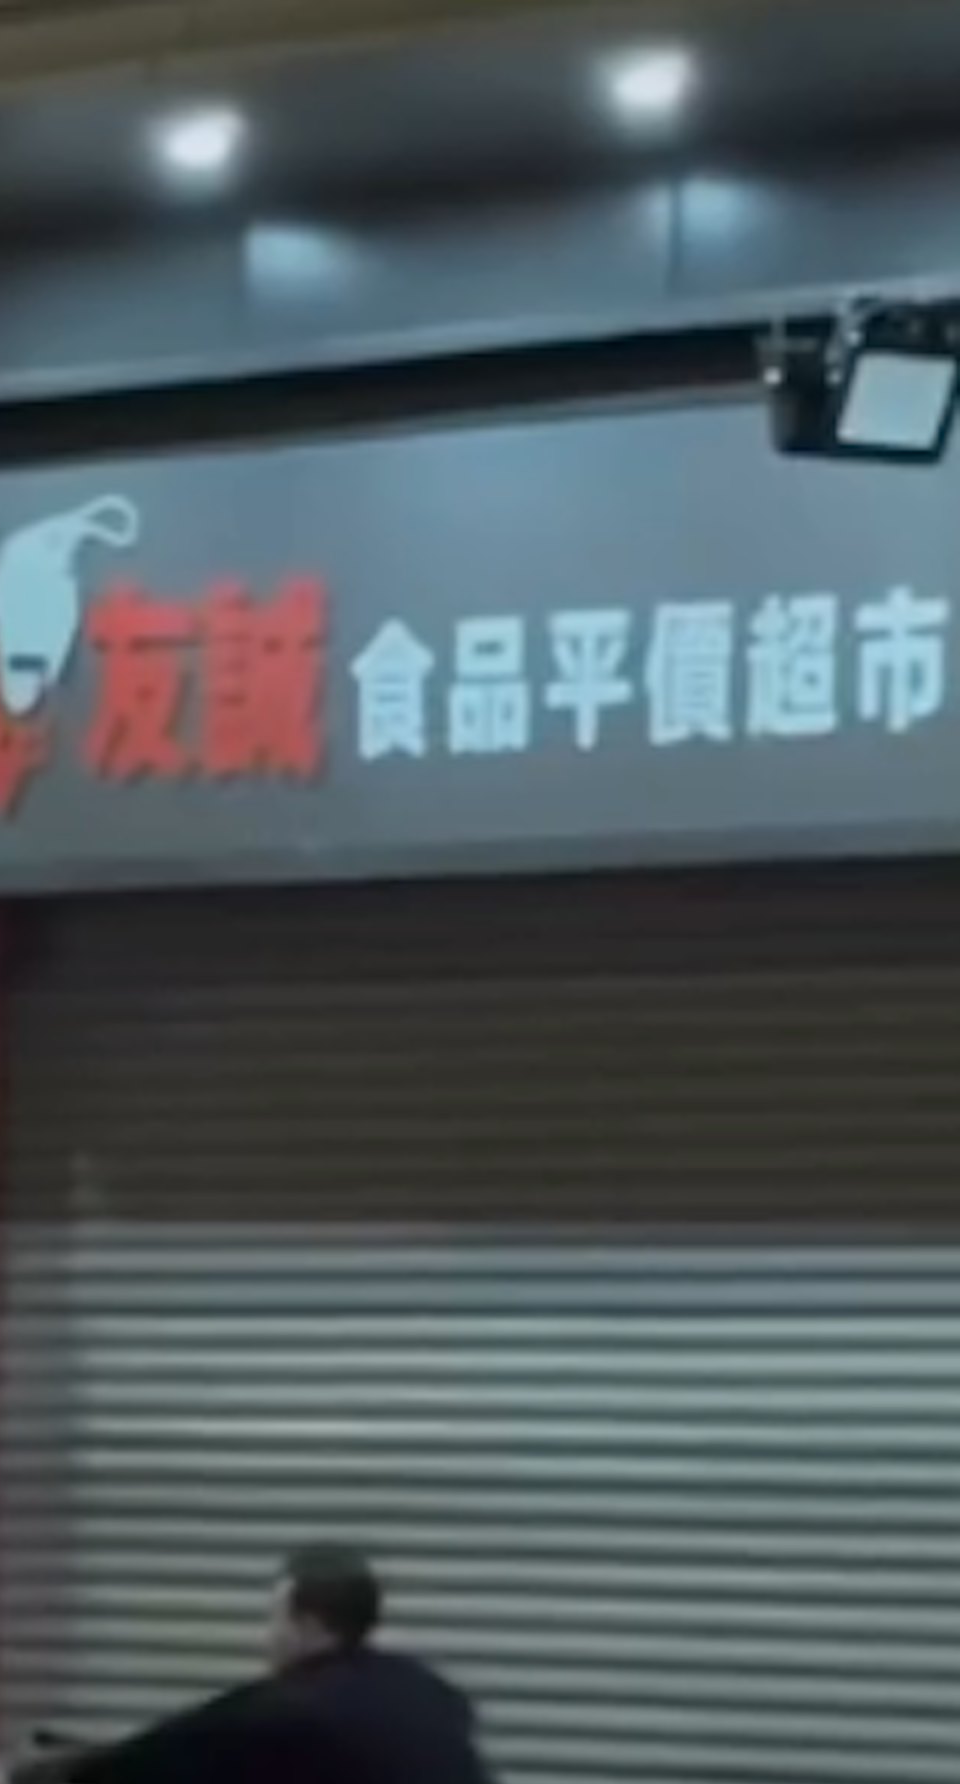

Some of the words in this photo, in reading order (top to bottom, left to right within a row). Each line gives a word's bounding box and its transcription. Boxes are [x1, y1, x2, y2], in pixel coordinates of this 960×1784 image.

[350, 586, 948, 758] 食品平價超市
